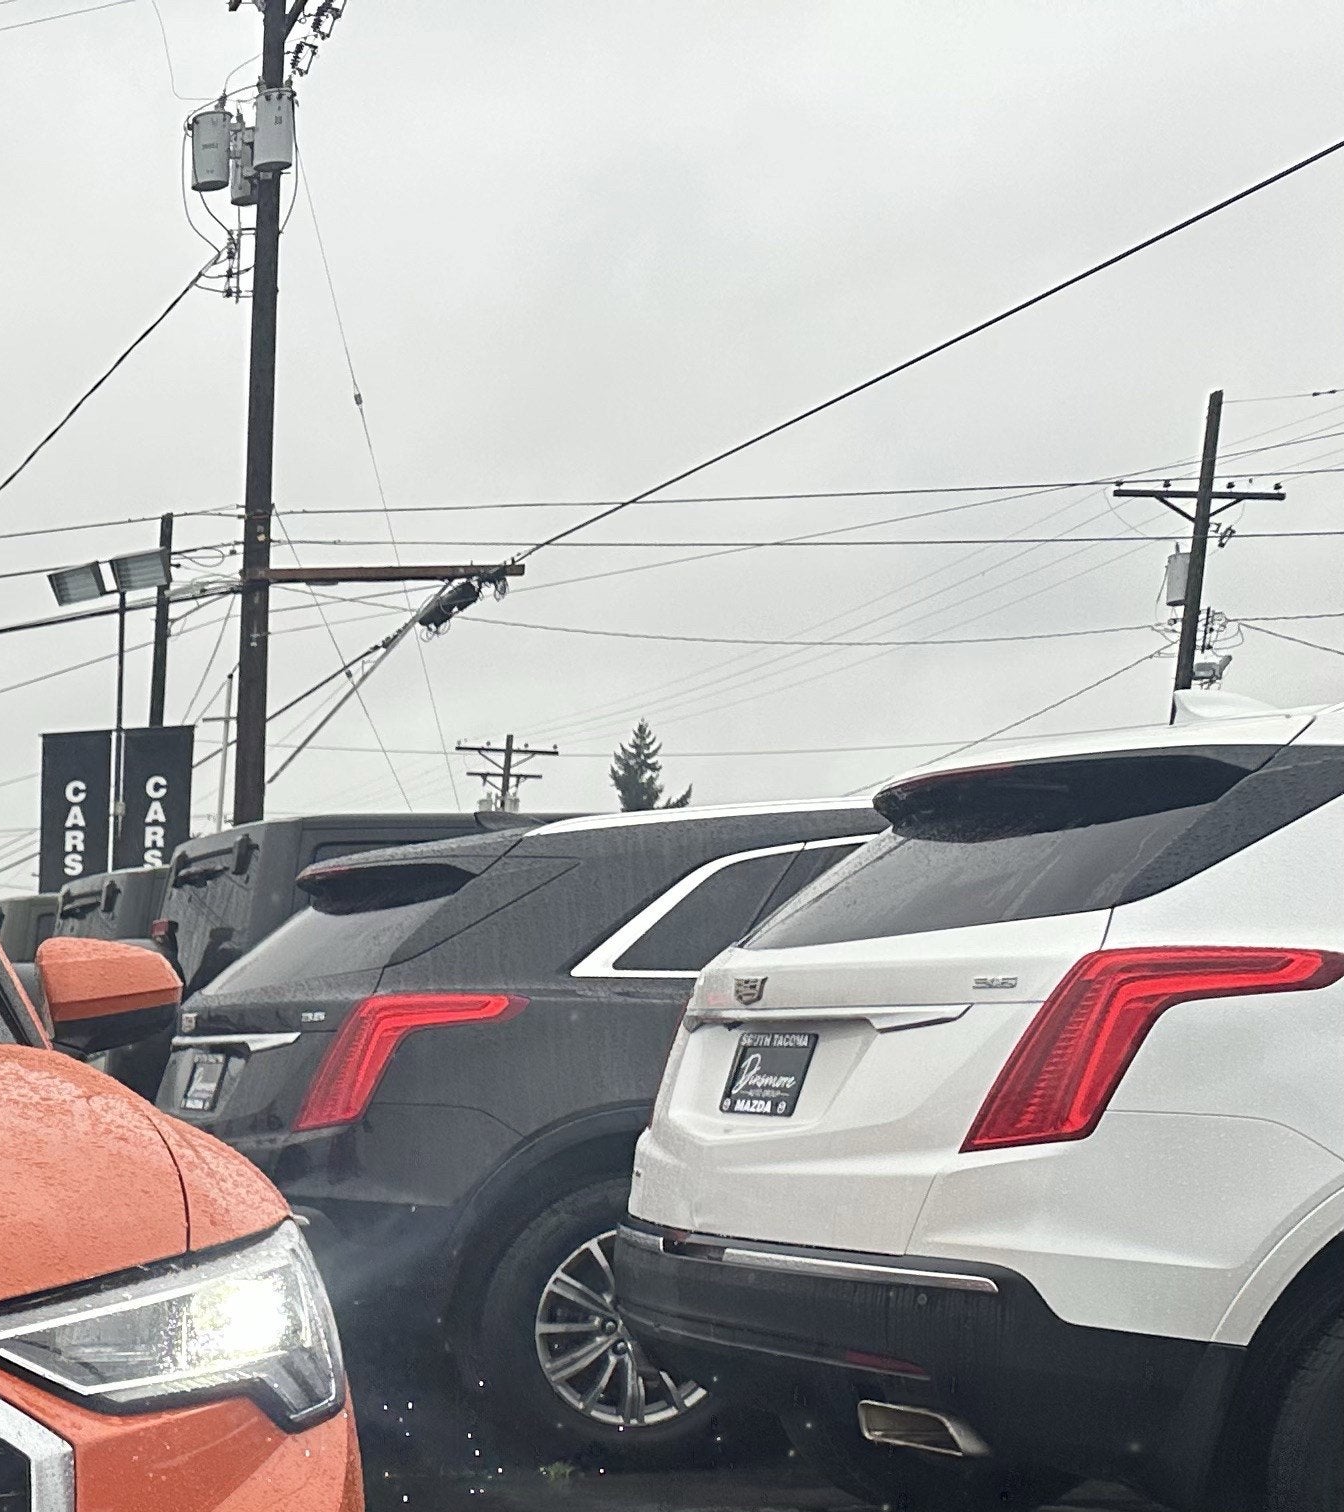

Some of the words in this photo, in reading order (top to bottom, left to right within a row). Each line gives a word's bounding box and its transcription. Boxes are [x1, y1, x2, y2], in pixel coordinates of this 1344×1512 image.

[64, 779, 87, 877] CARS
[143, 774, 168, 869] CARS
[734, 1099, 772, 1114] MAZDA
